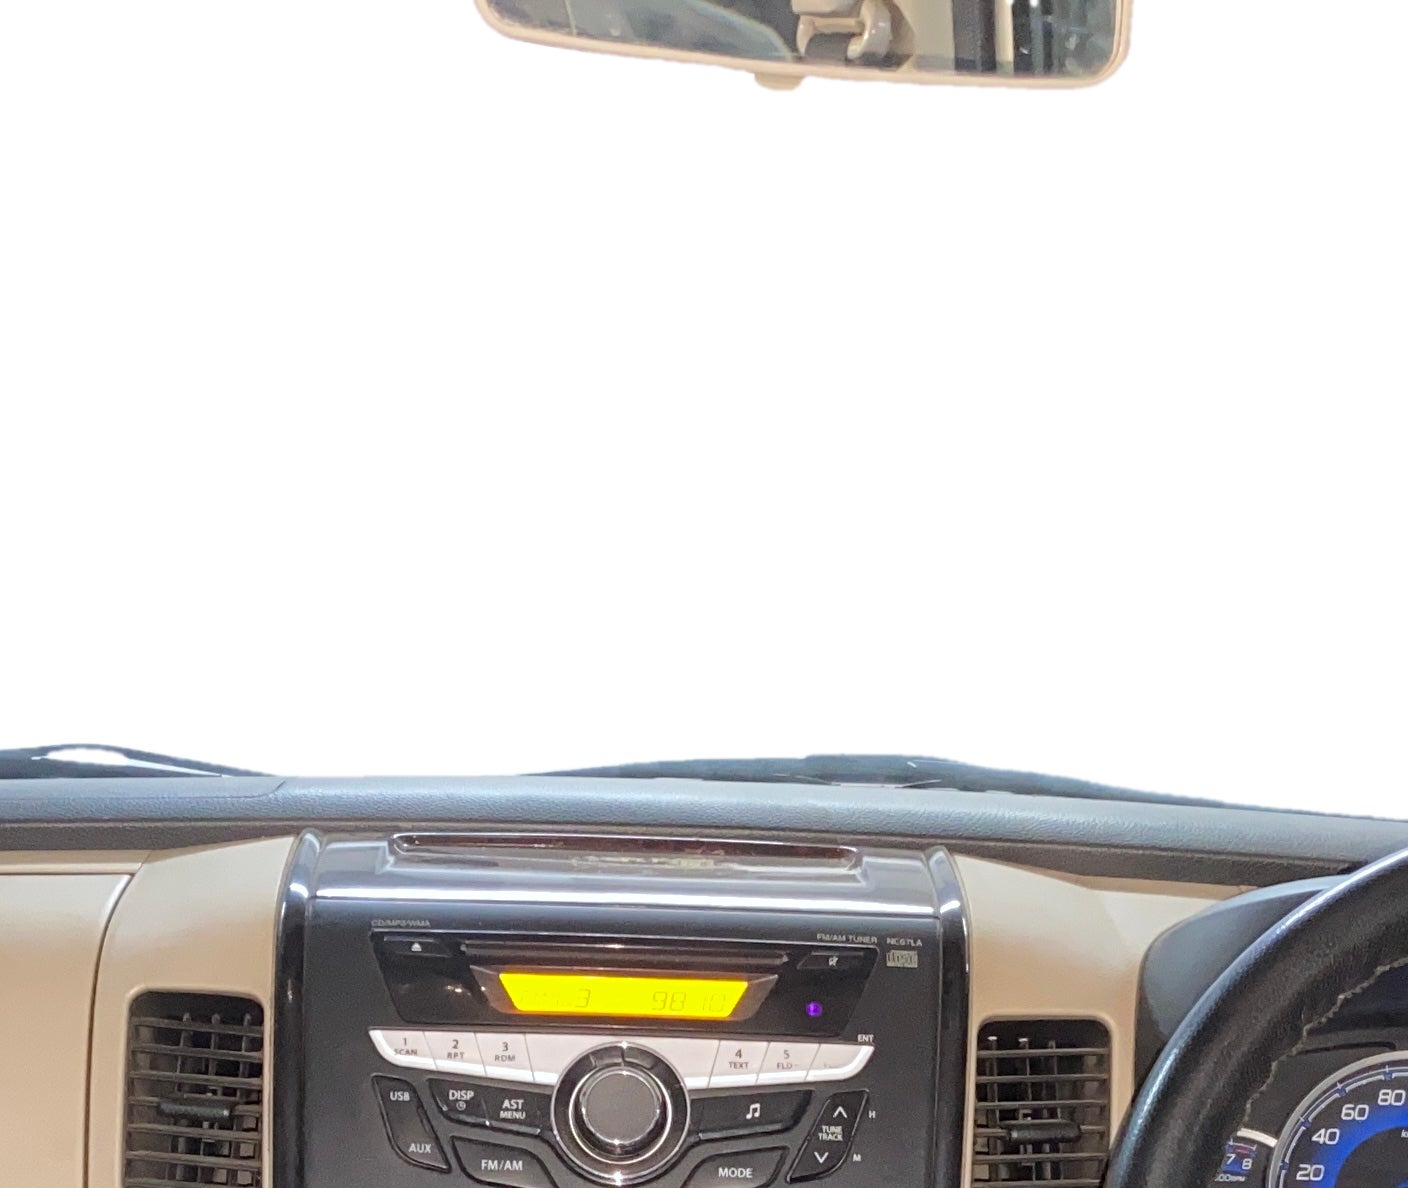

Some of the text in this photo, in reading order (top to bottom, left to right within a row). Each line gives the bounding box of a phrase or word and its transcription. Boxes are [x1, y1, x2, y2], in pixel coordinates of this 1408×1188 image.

[847, 934, 878, 945] TUNER
[857, 1033, 875, 1044] ENT
[452, 1039, 459, 1050] 2
[501, 1041, 509, 1052] 3
[393, 1047, 418, 1057] SCAN
[446, 1051, 465, 1061] RPT
[734, 1048, 743, 1060] 4
[783, 1049, 791, 1060] 5
[494, 1053, 516, 1063] RDM
[728, 1061, 750, 1070] TEXT
[389, 1091, 411, 1102] USB
[448, 1089, 475, 1101] DISP
[1377, 1088, 1406, 1106] 80
[501, 1098, 524, 1110] AST
[499, 1110, 526, 1120] MENU
[868, 1110, 877, 1120] H
[1340, 1103, 1370, 1121] 60
[821, 1125, 843, 1134] TUNE
[817, 1132, 843, 1142] TRACK
[1311, 1127, 1340, 1145] 40
[408, 1143, 432, 1154] AUX
[852, 1153, 862, 1163] M
[1225, 1153, 1236, 1166] 7
[1242, 1157, 1253, 1170] 8
[480, 1159, 524, 1172] FM/AM
[718, 1166, 754, 1179] MODE
[1295, 1163, 1326, 1181] 20
